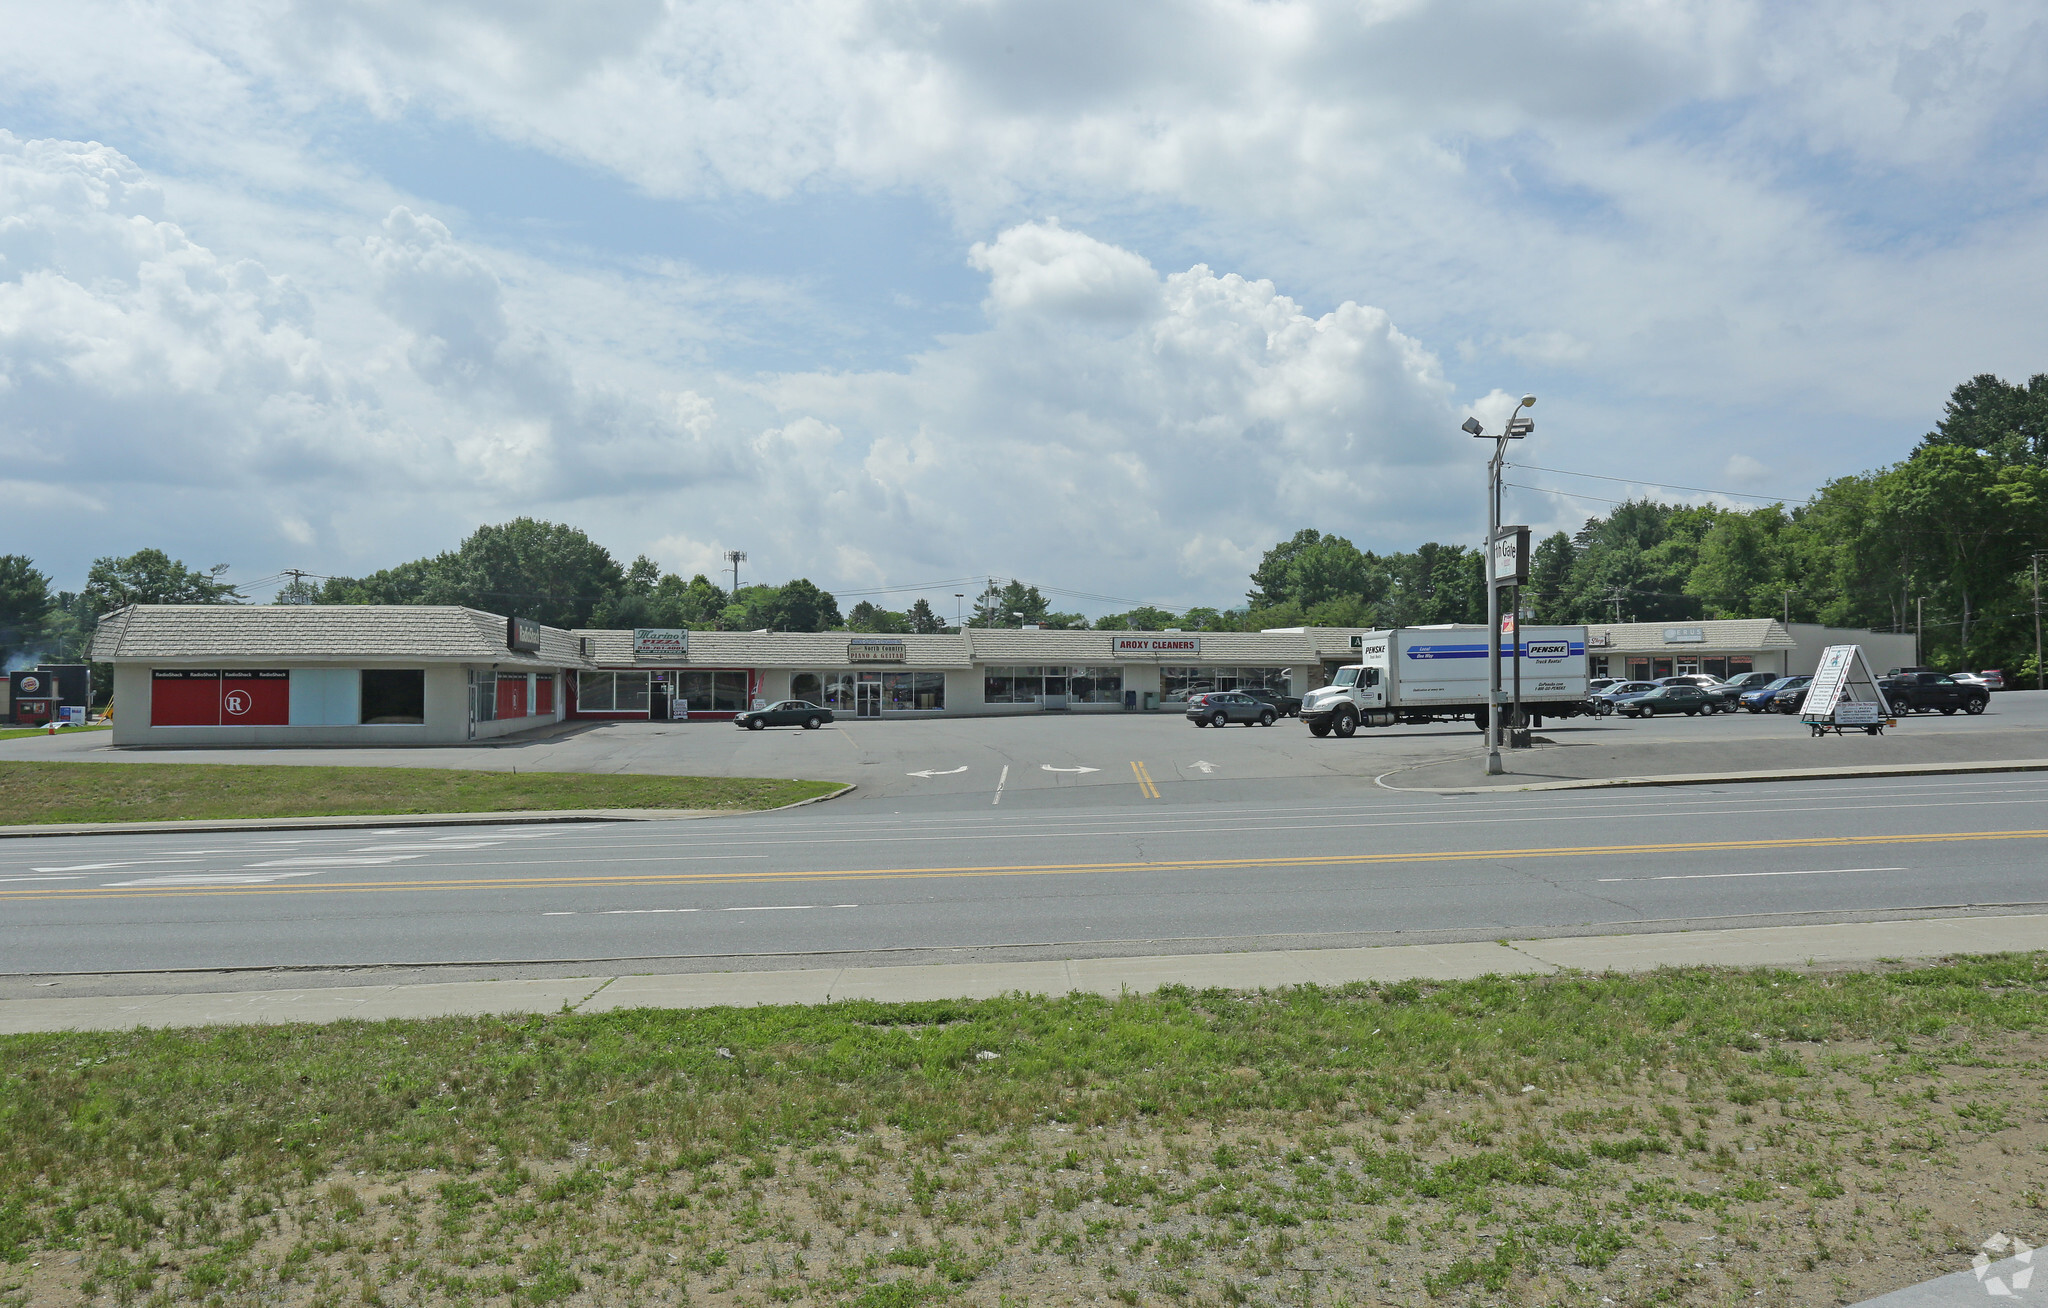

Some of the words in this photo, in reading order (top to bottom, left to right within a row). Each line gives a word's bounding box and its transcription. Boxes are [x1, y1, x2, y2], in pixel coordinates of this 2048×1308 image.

[1502, 540, 1516, 558] Gate
[635, 630, 687, 640] Marino's
[1120, 640, 1149, 649] AROXY
[1152, 641, 1195, 649] CLEANERS
[1530, 645, 1566, 653] PENSKE
[1365, 645, 1386, 654] PENSKE
